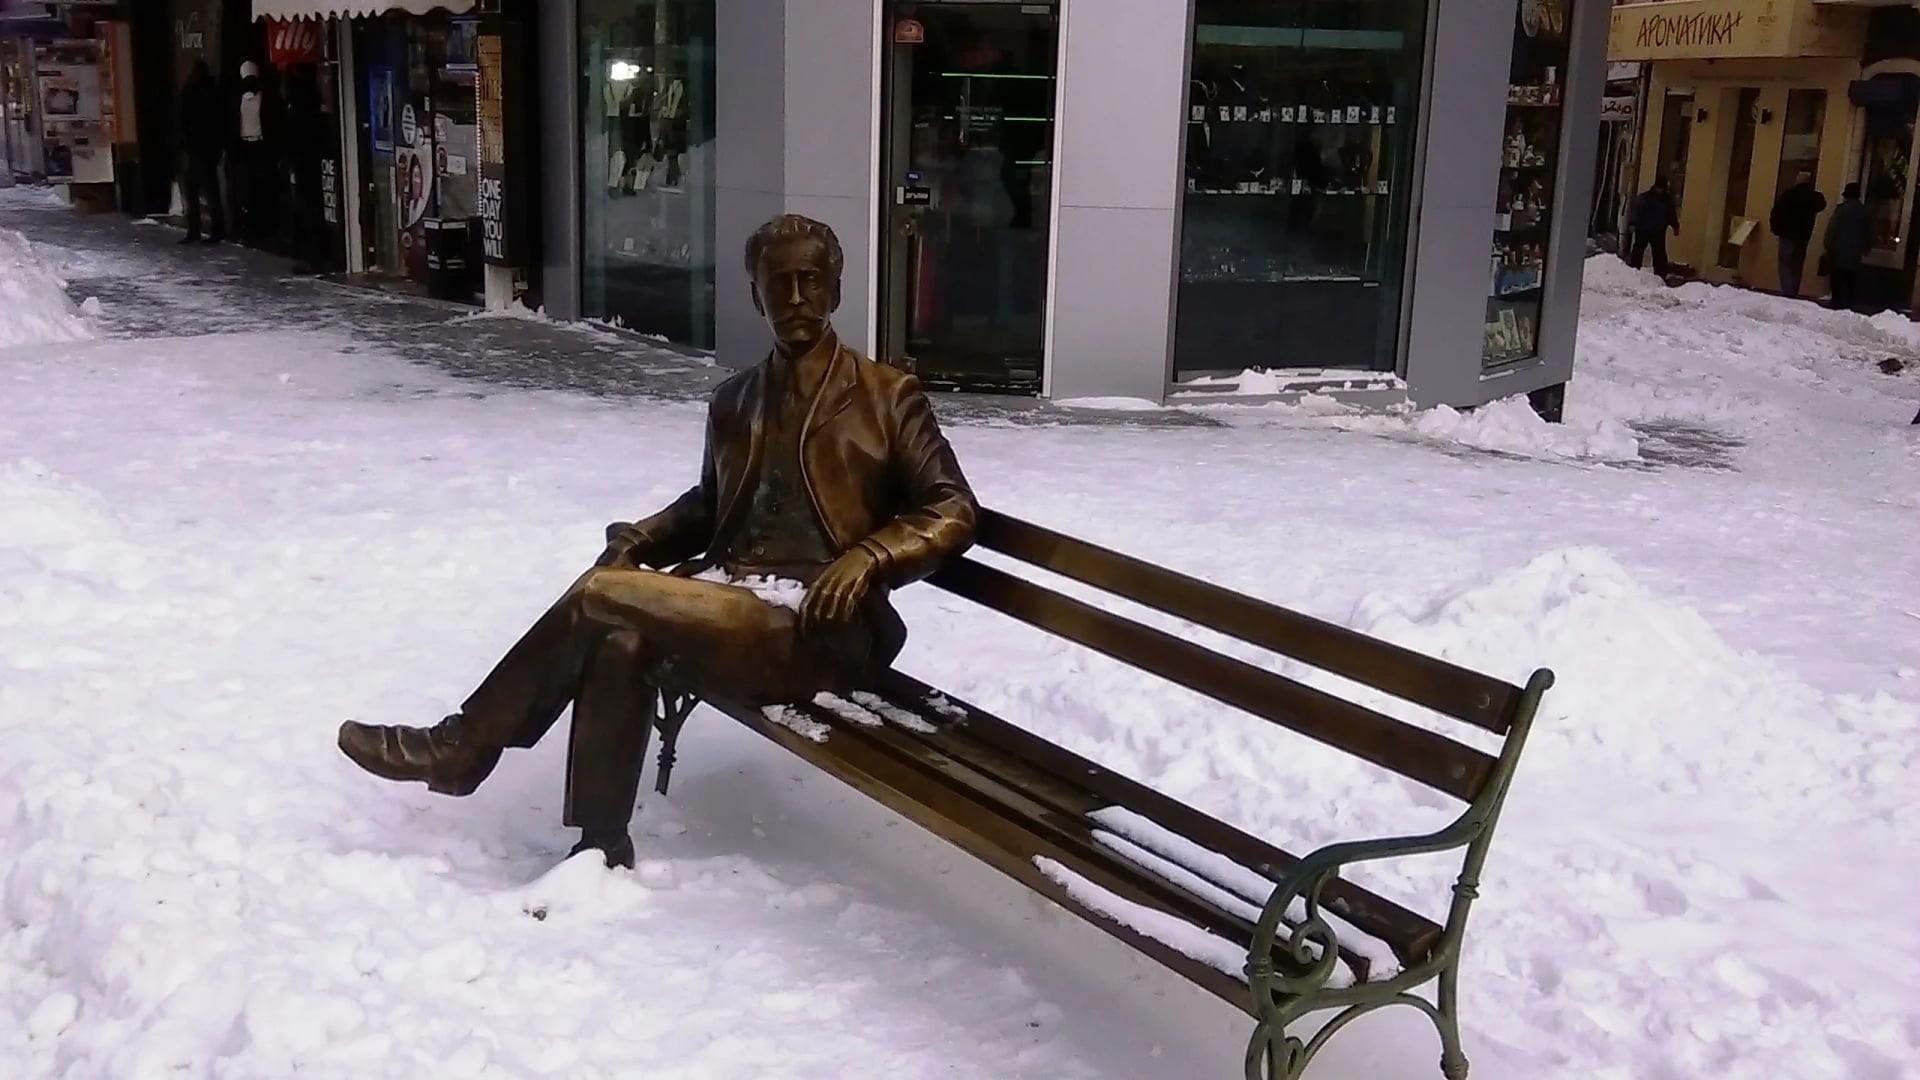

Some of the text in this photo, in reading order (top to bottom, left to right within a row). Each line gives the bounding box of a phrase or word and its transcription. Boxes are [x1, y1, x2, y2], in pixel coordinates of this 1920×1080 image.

[274, 20, 317, 56] illy
[482, 178, 502, 200] ONE
[482, 199, 502, 221] DAY
[483, 219, 503, 241] YOU
[483, 238, 505, 260] WILL
